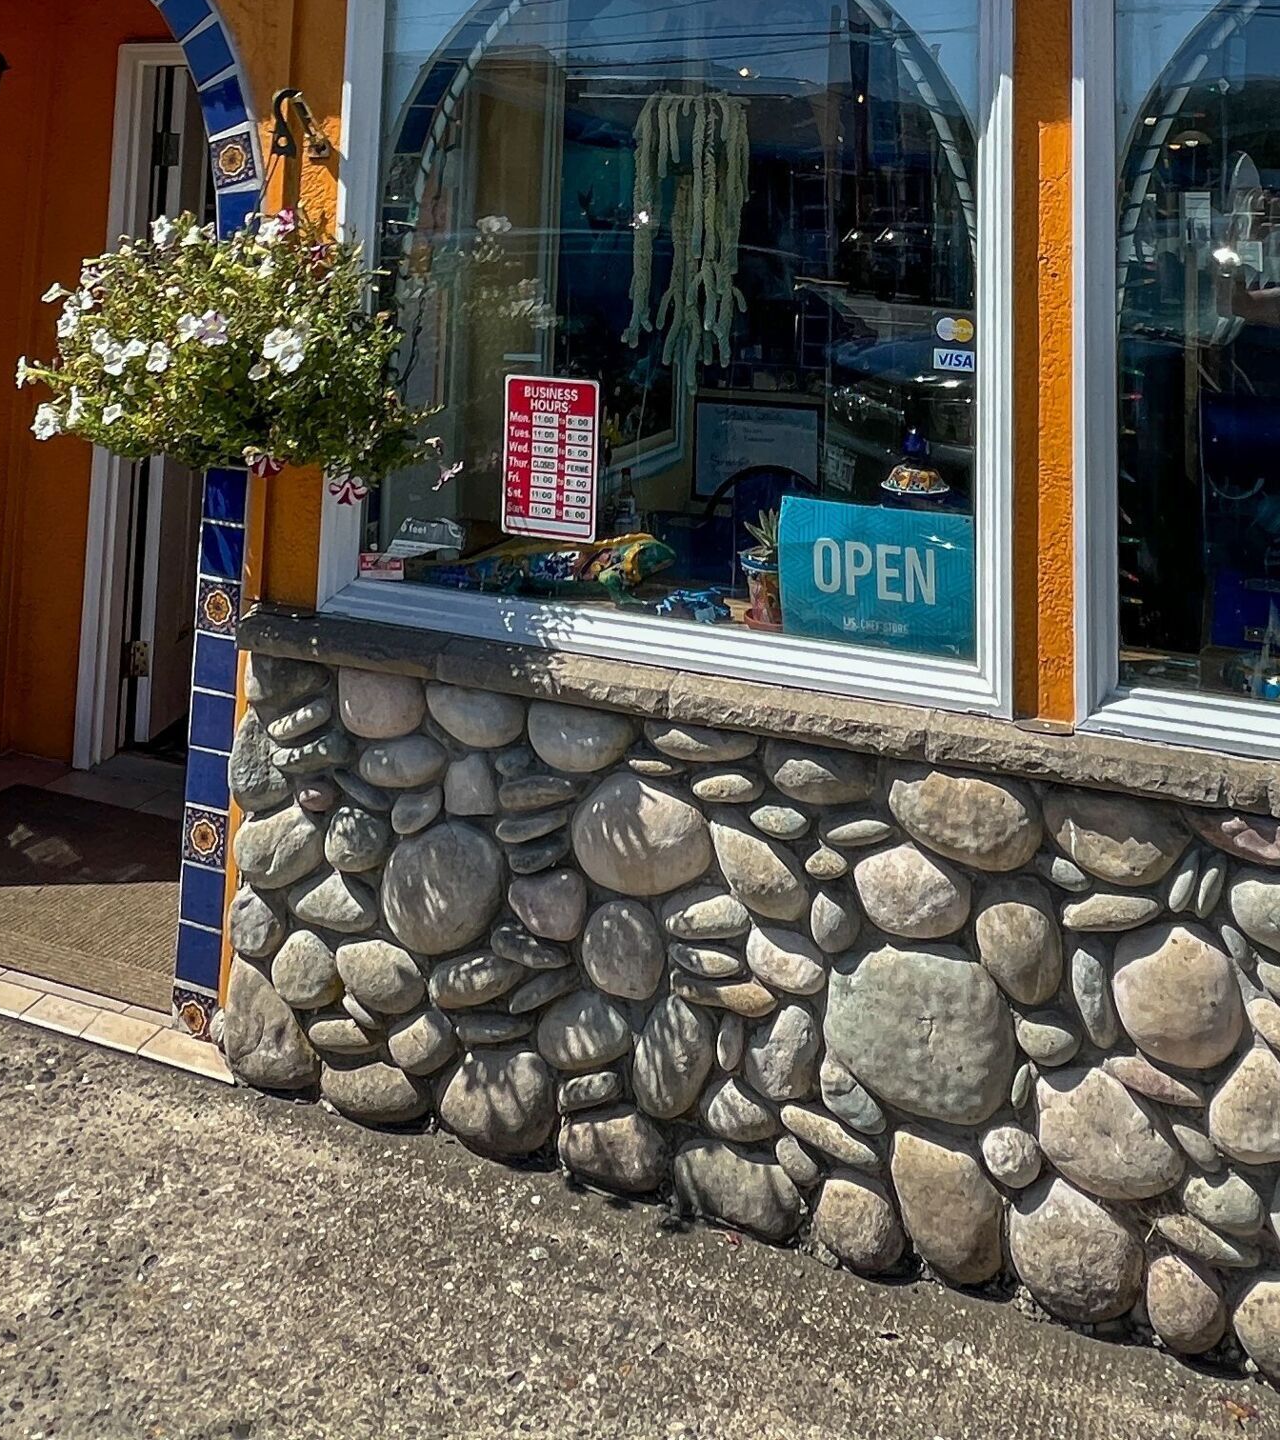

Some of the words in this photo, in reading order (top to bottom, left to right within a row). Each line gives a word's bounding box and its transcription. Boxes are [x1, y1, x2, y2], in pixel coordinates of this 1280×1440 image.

[938, 353, 973, 368] VISA
[524, 385, 578, 401] BUSINESS
[533, 460, 555, 469] CLOSED
[409, 523, 427, 534] feet
[813, 537, 936, 605] OPEN
